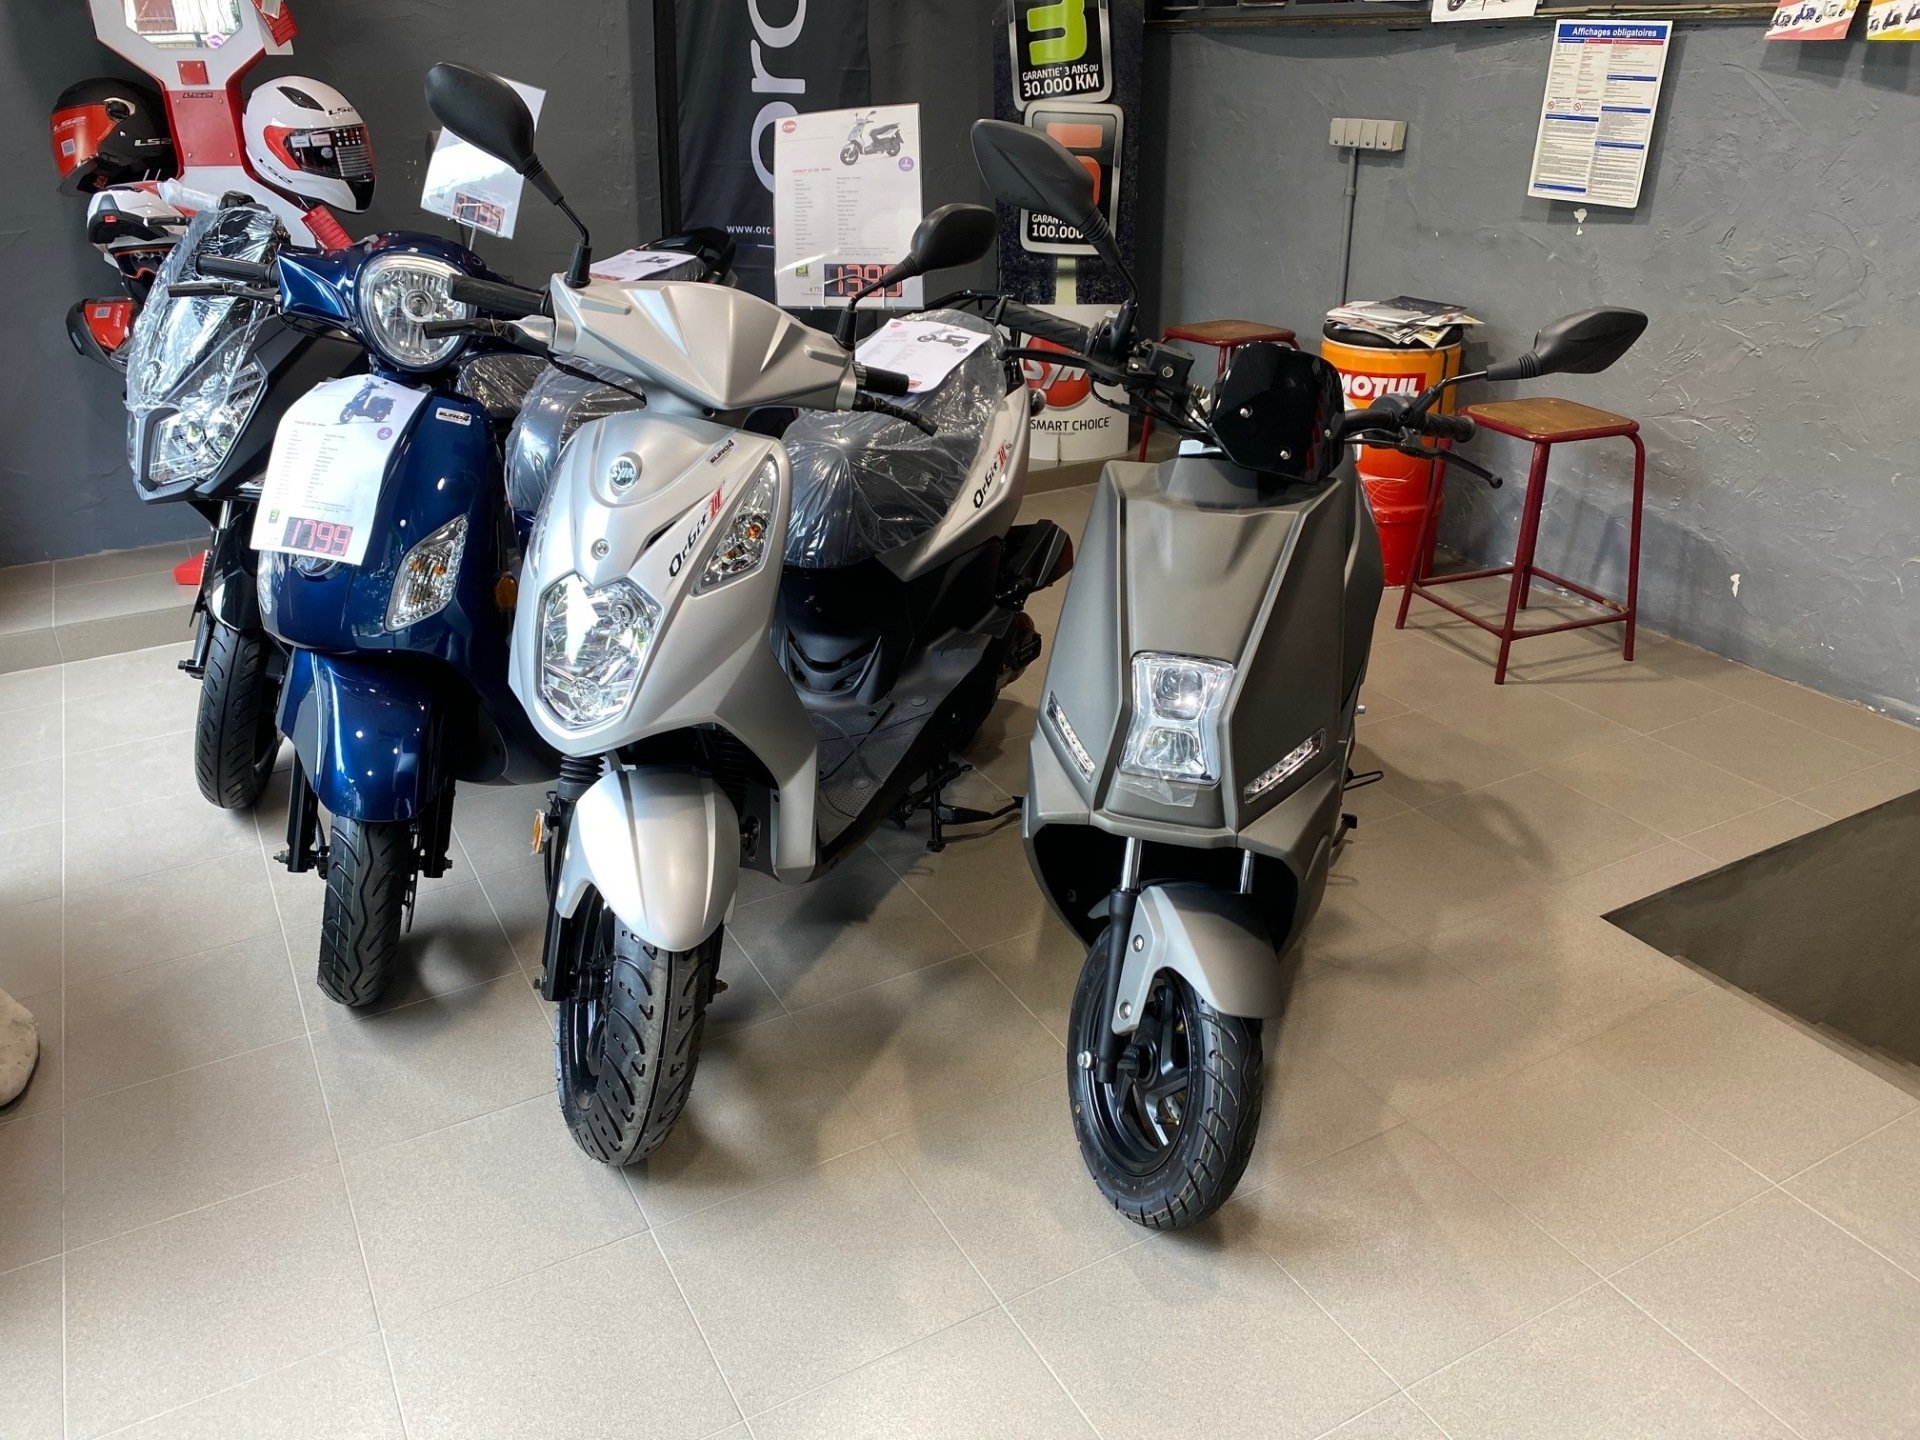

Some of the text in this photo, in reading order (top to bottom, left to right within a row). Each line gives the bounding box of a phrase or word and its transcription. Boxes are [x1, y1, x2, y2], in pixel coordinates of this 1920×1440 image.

[1572, 27, 1657, 37] Affichages obligatoires
[1064, 66, 1070, 75] 3
[1071, 64, 1088, 74] ANS
[1024, 73, 1100, 97] 30.000 KM
[1031, 213, 1065, 225] GARAN
[726, 225, 774, 235] www.orc
[1030, 419, 1070, 431] SMART
[973, 461, 998, 508] Orbit
[291, 518, 353, 557] 1799
[668, 513, 707, 577] Orbit
